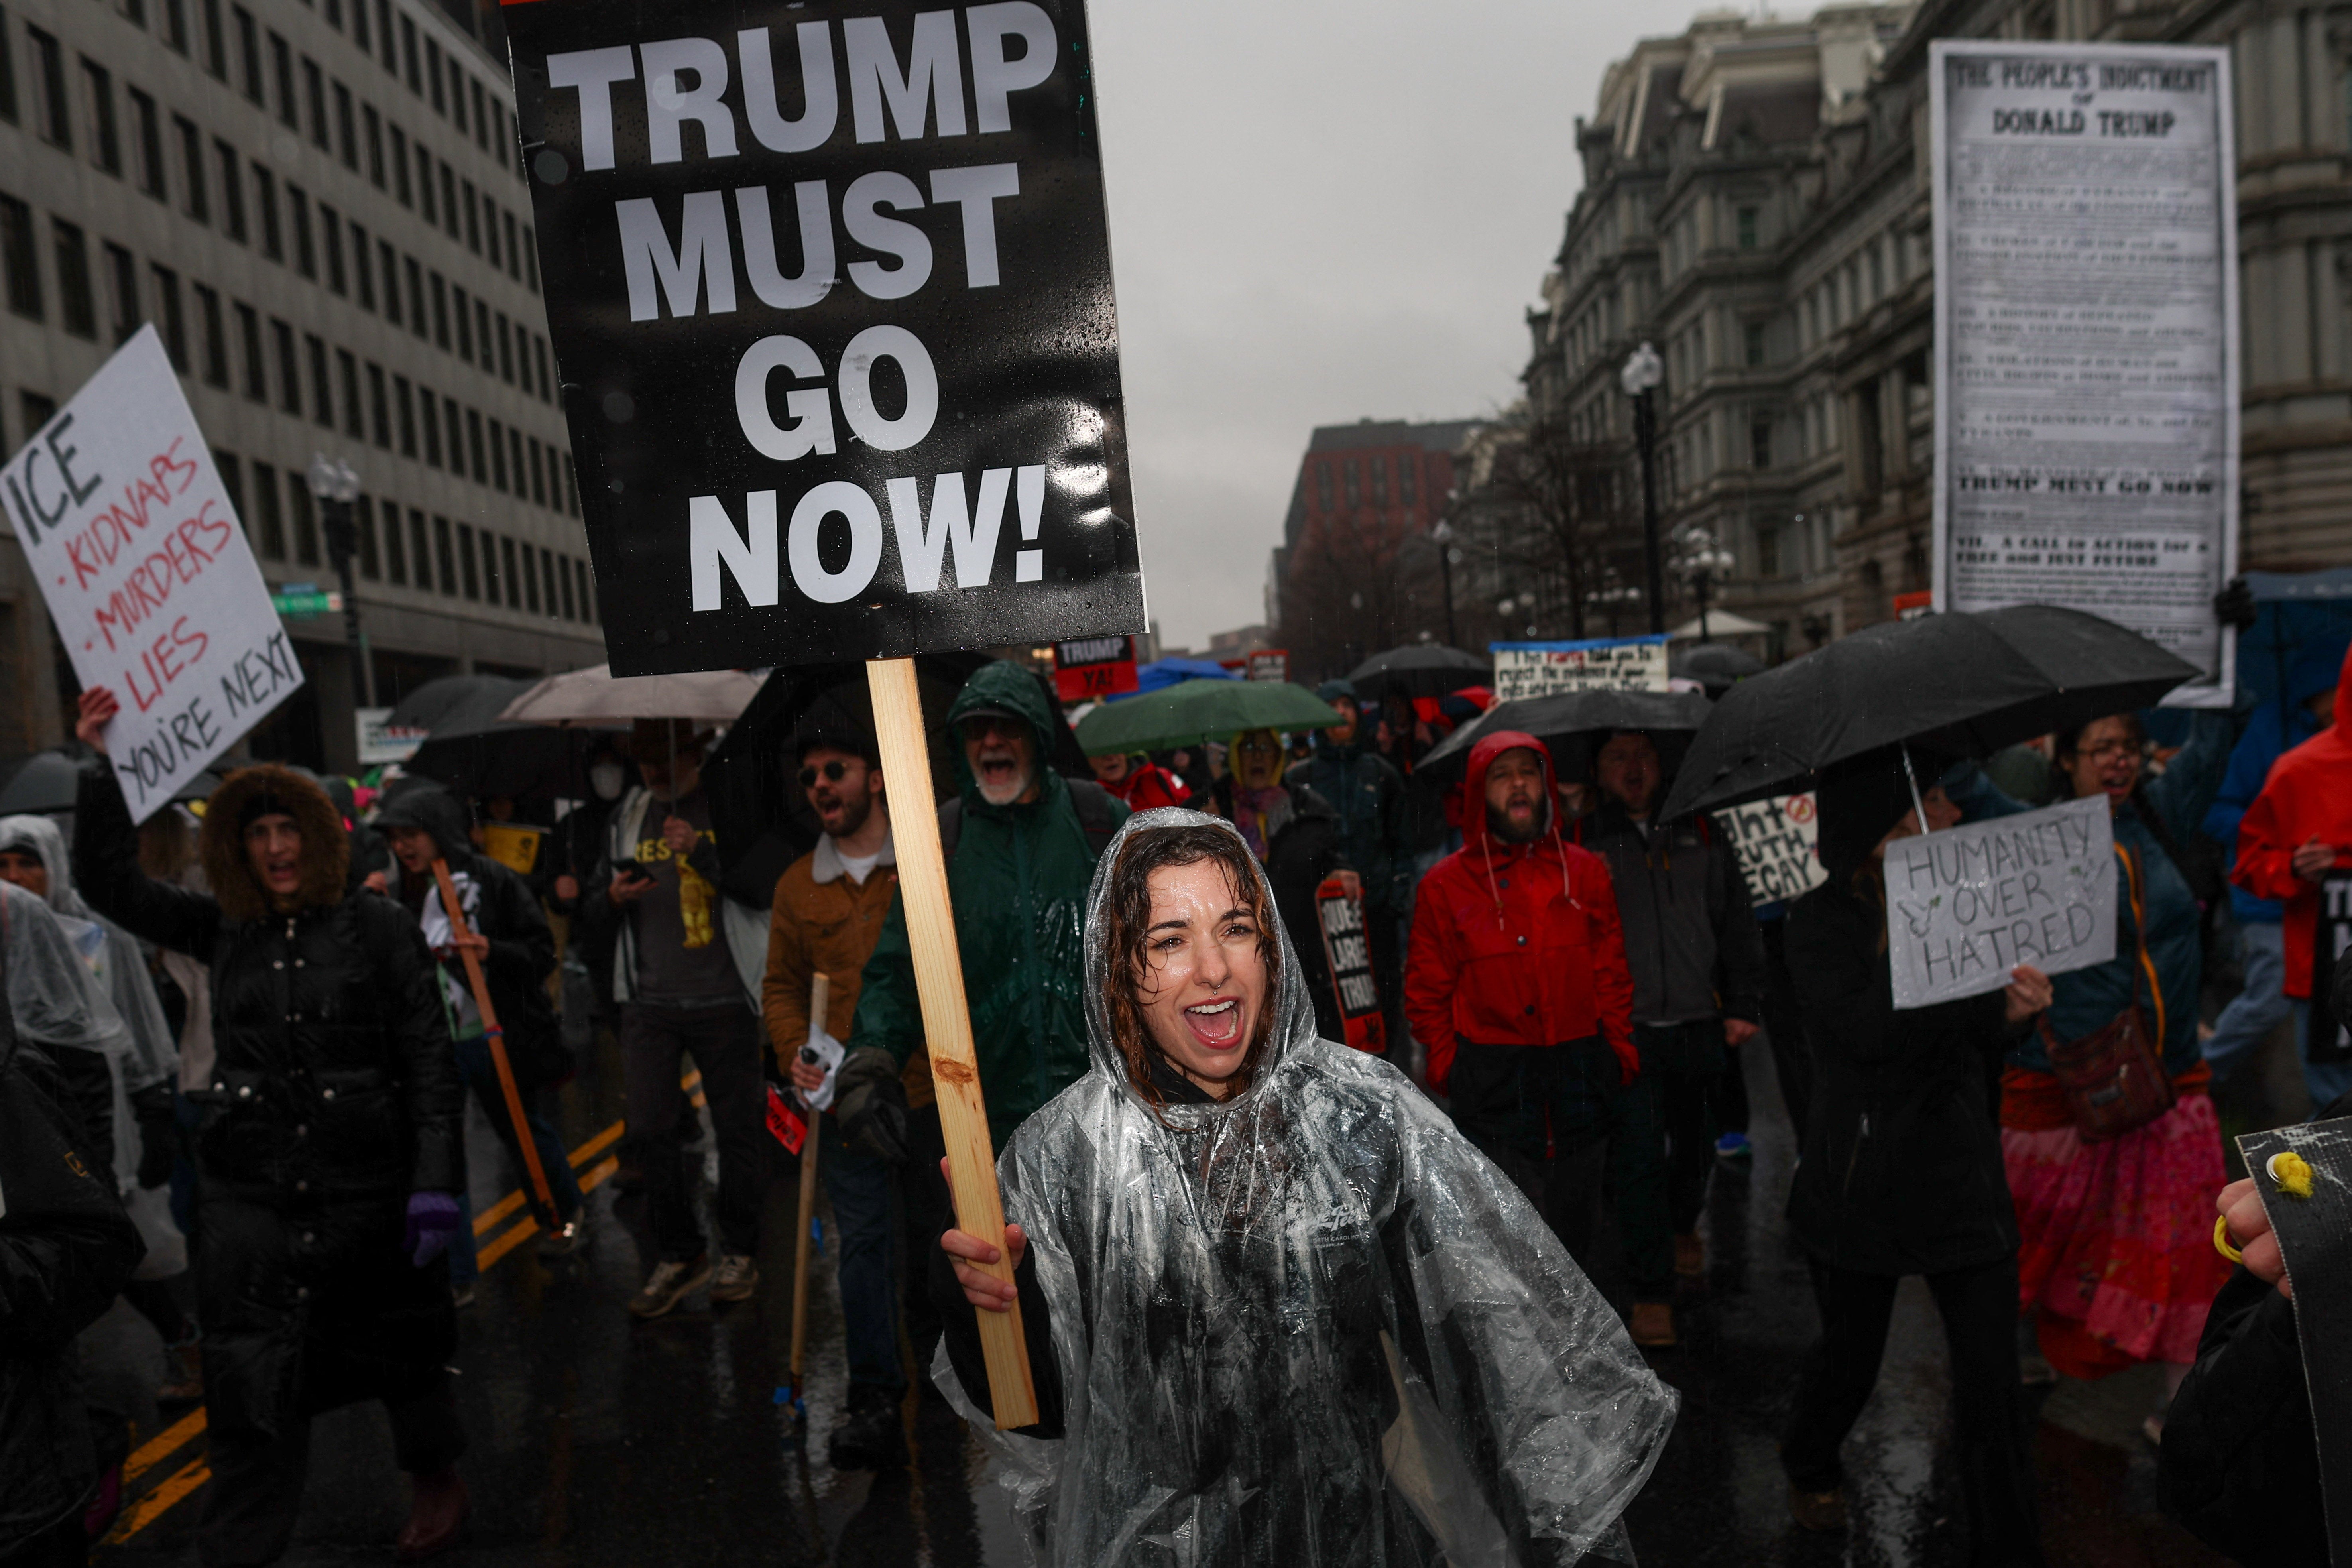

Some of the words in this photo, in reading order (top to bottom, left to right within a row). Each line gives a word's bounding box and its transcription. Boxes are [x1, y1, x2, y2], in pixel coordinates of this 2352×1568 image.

[546, 1, 1058, 172] TRUMP
[1956, 62, 1992, 88] THE
[2002, 63, 2090, 90] PEOPLE'S
[2099, 65, 2208, 93] INDICTMENT
[1993, 110, 2085, 135] DONALD
[2096, 111, 2177, 137] TRUMP
[615, 163, 1020, 322] MUST
[735, 324, 939, 461] GO
[6, 413, 102, 546] ICE
[65, 436, 197, 591] KIDNAPS
[1959, 477, 2039, 492] TRUMP
[2048, 478, 2107, 494] MUST
[2118, 480, 2150, 494] GO
[2161, 480, 2212, 494] NOW
[95, 499, 232, 653] MURDERS
[689, 464, 1045, 612] NOW!
[125, 615, 208, 712] LIES
[1061, 638, 1124, 664] TRUMP
[1082, 668, 1114, 691] YA!
[118, 697, 222, 805] YOU'RE
[220, 630, 295, 718] NEXT
[1717, 799, 1785, 844] ght
[1731, 828, 1806, 868] RUTH
[1904, 813, 2092, 891] HUMANITY
[1742, 852, 1813, 901] ECAY
[1952, 869, 2056, 926] OVER
[1922, 902, 2096, 986] HATRED
